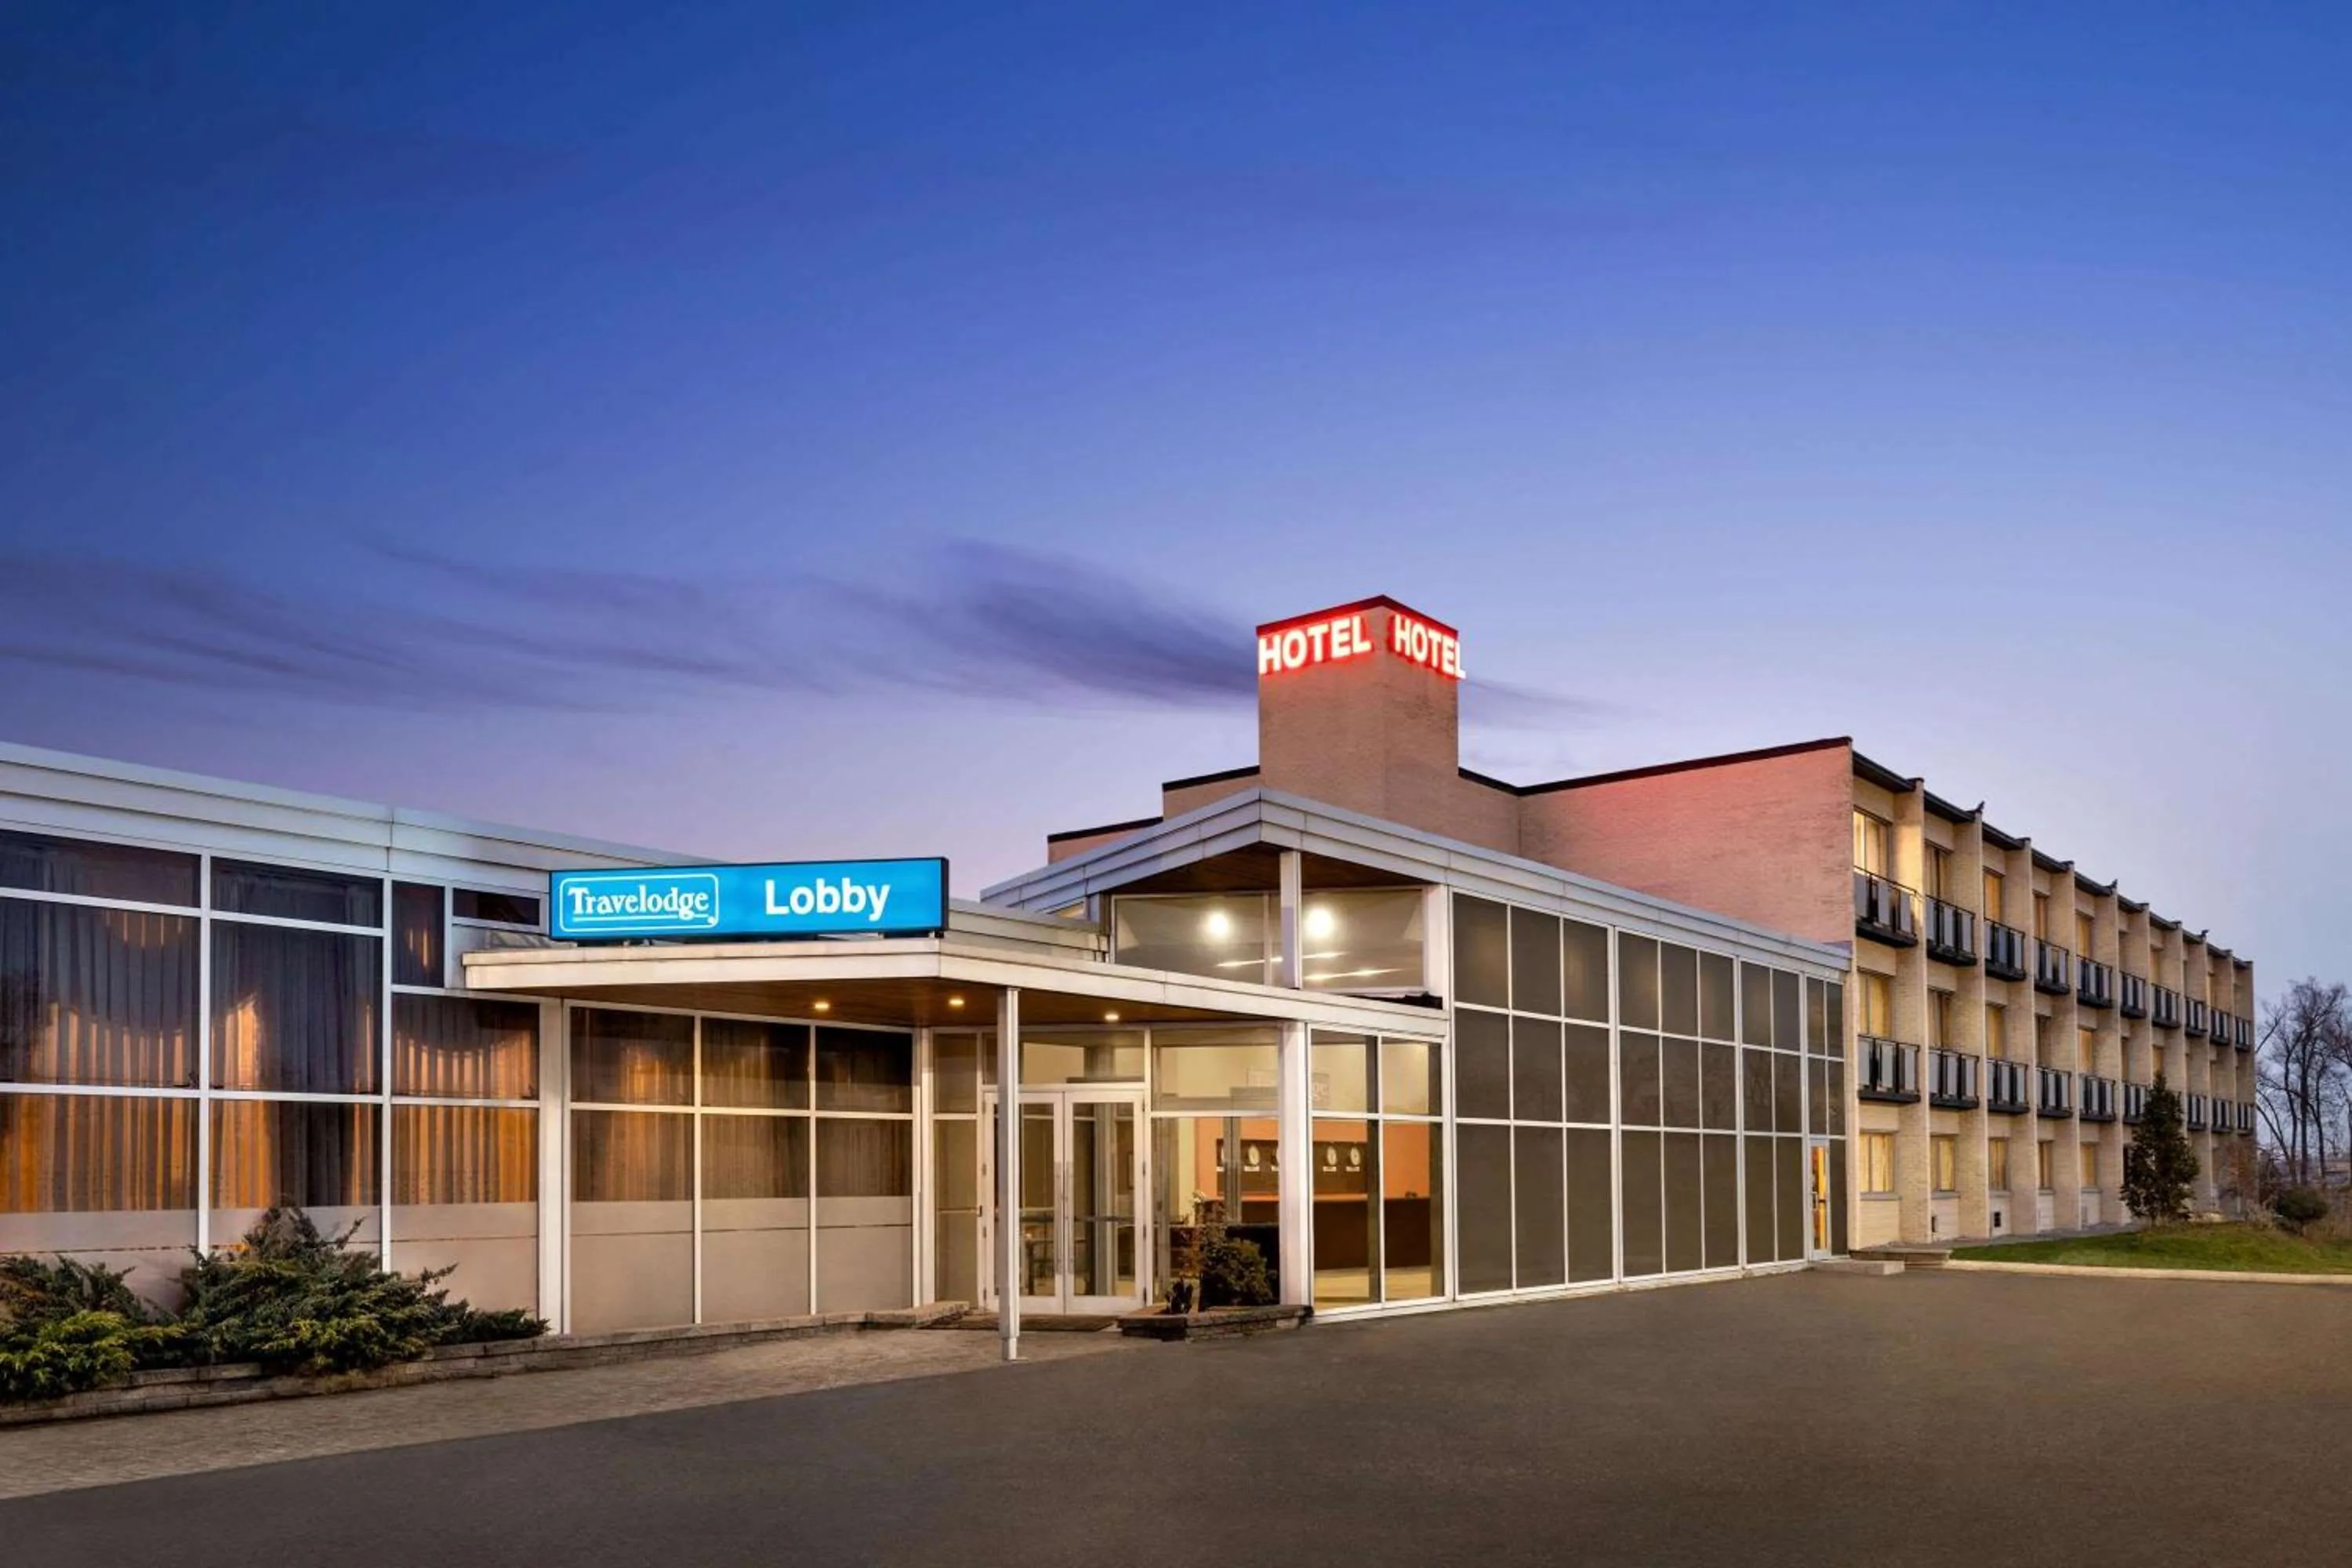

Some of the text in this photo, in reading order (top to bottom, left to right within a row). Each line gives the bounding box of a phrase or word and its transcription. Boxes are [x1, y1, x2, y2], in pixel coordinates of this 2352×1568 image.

[1258, 615, 1372, 675] HOTEL
[1394, 614, 1466, 680] HOTEL
[568, 877, 890, 921] Travelodge Lobby
